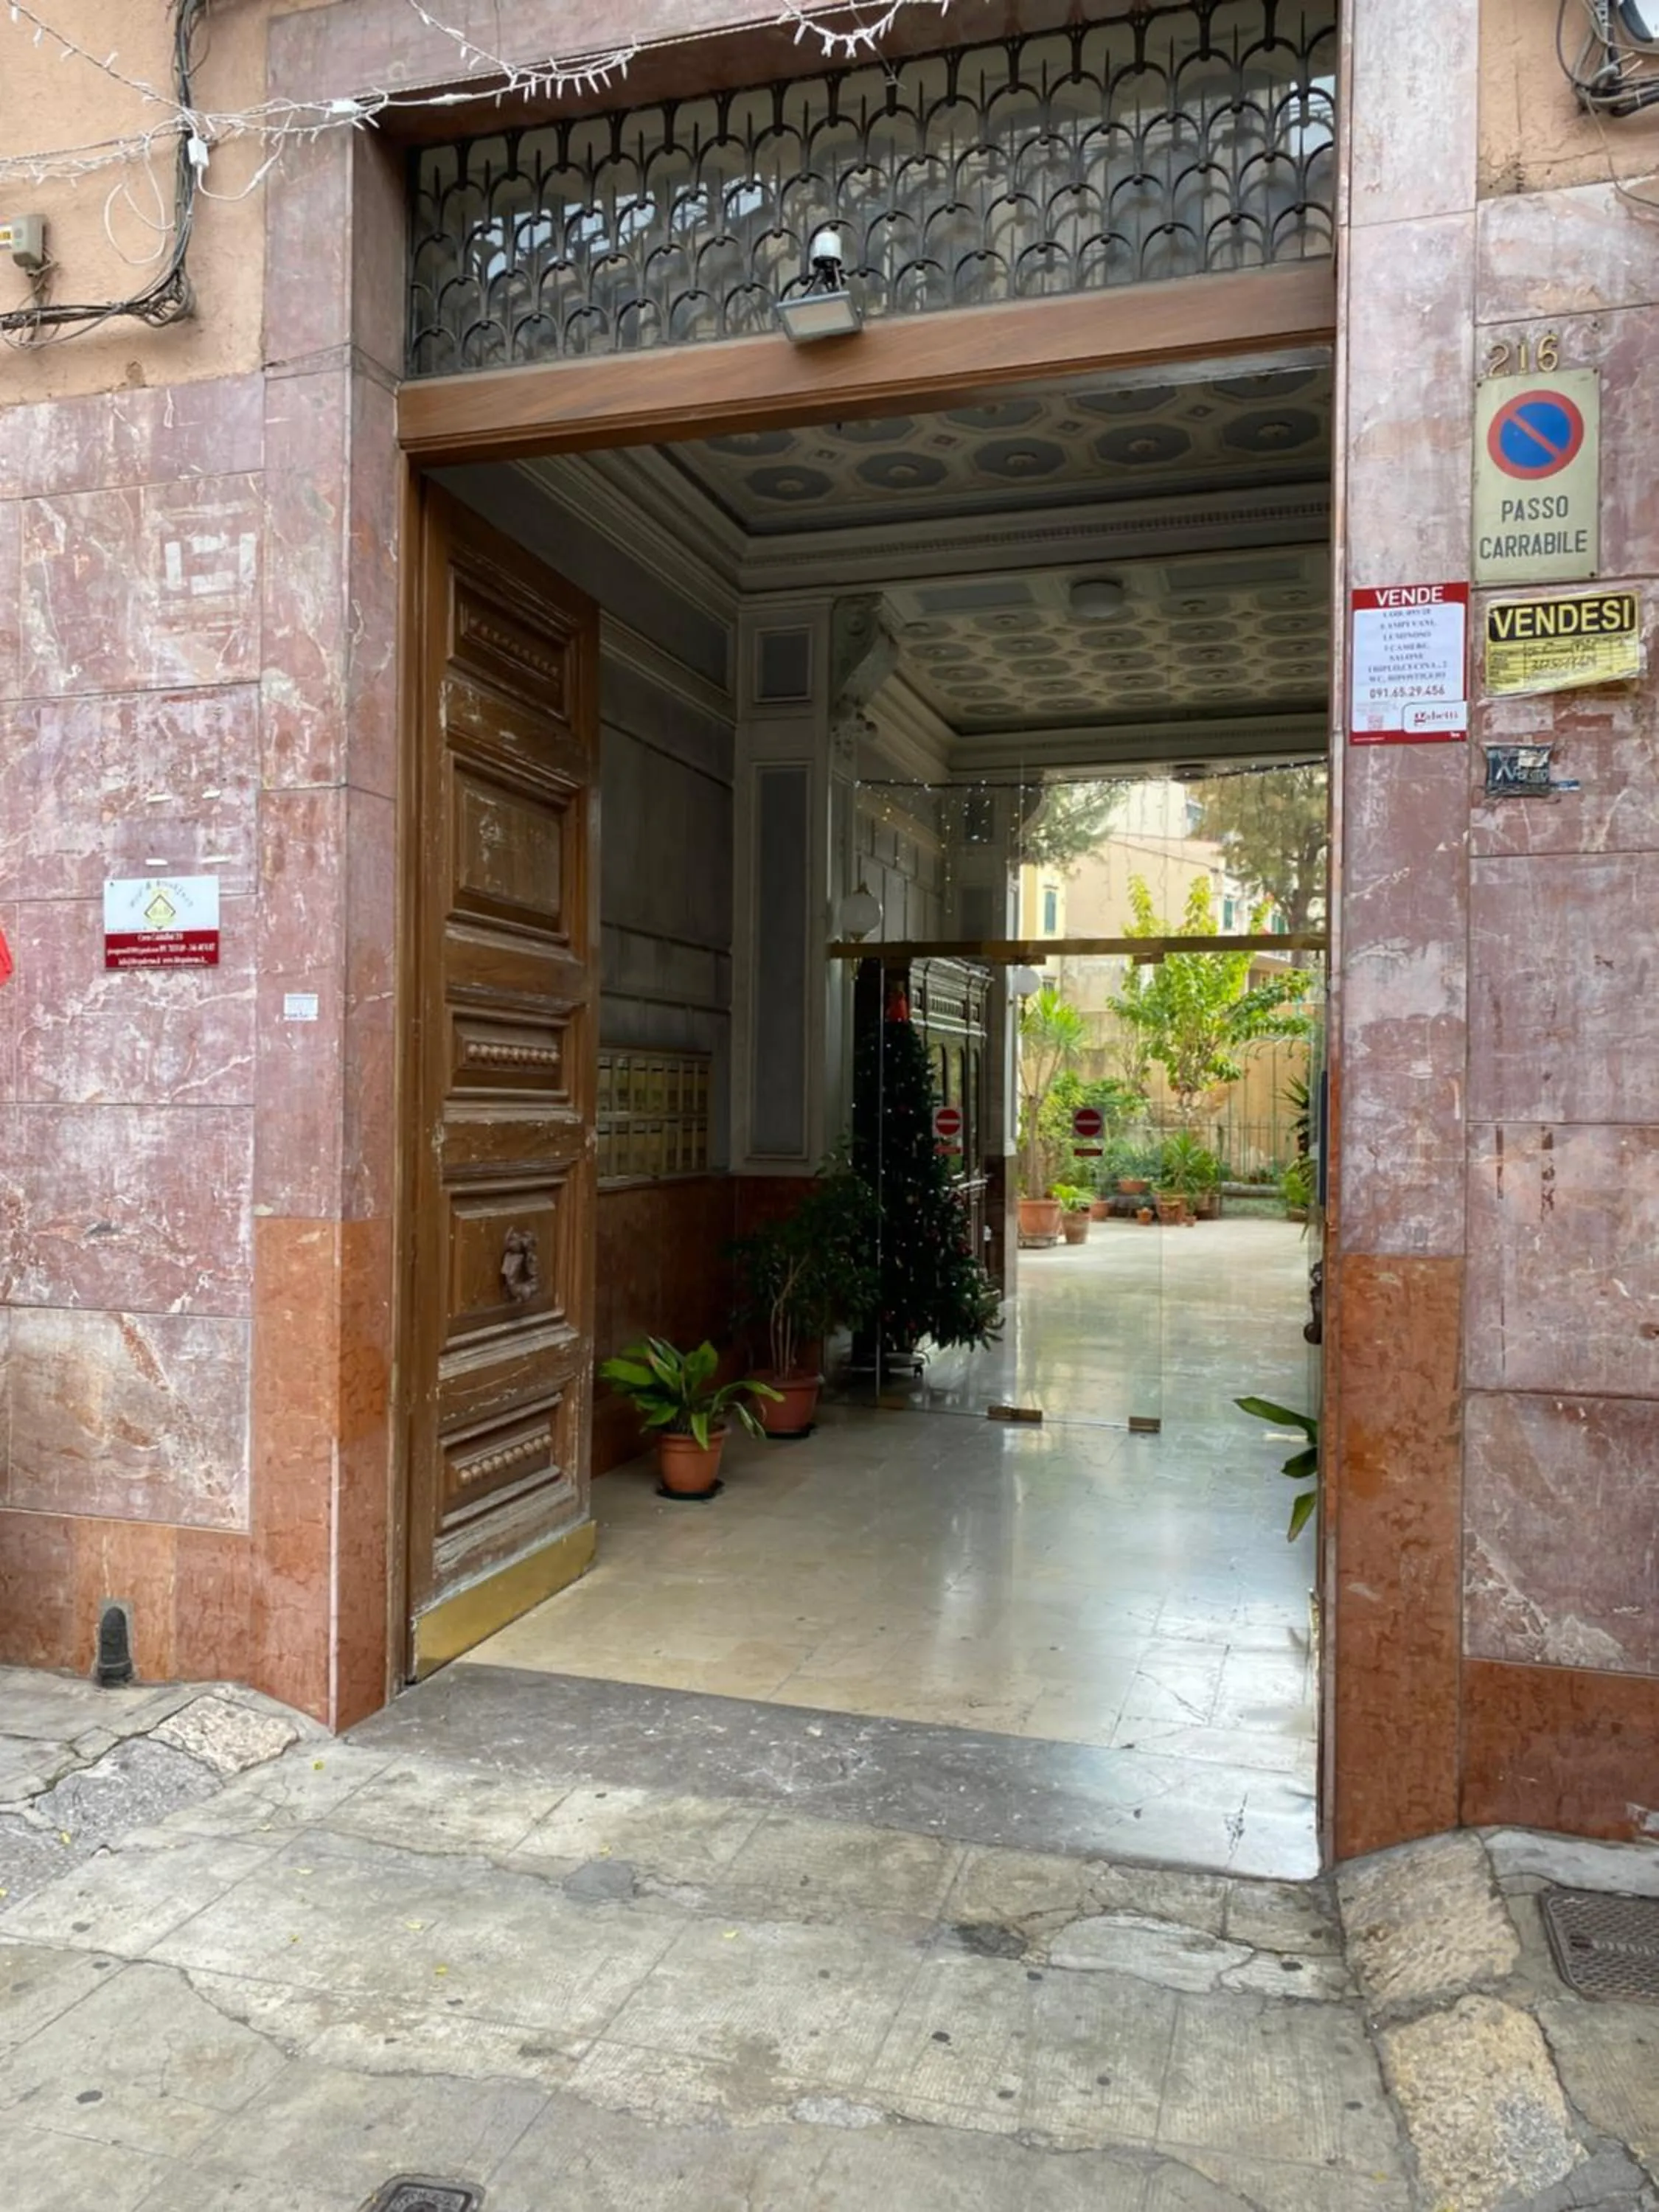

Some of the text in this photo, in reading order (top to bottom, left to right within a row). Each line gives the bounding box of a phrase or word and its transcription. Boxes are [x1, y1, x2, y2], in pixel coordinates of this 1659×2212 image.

[1488, 334, 1559, 378] 216
[1500, 495, 1569, 524] PASSO
[1479, 529, 1588, 560] CARRABILE
[1374, 585, 1444, 607] VENDE
[1492, 599, 1630, 639] VENDESI
[1368, 684, 1446, 699] 091.65.29.456
